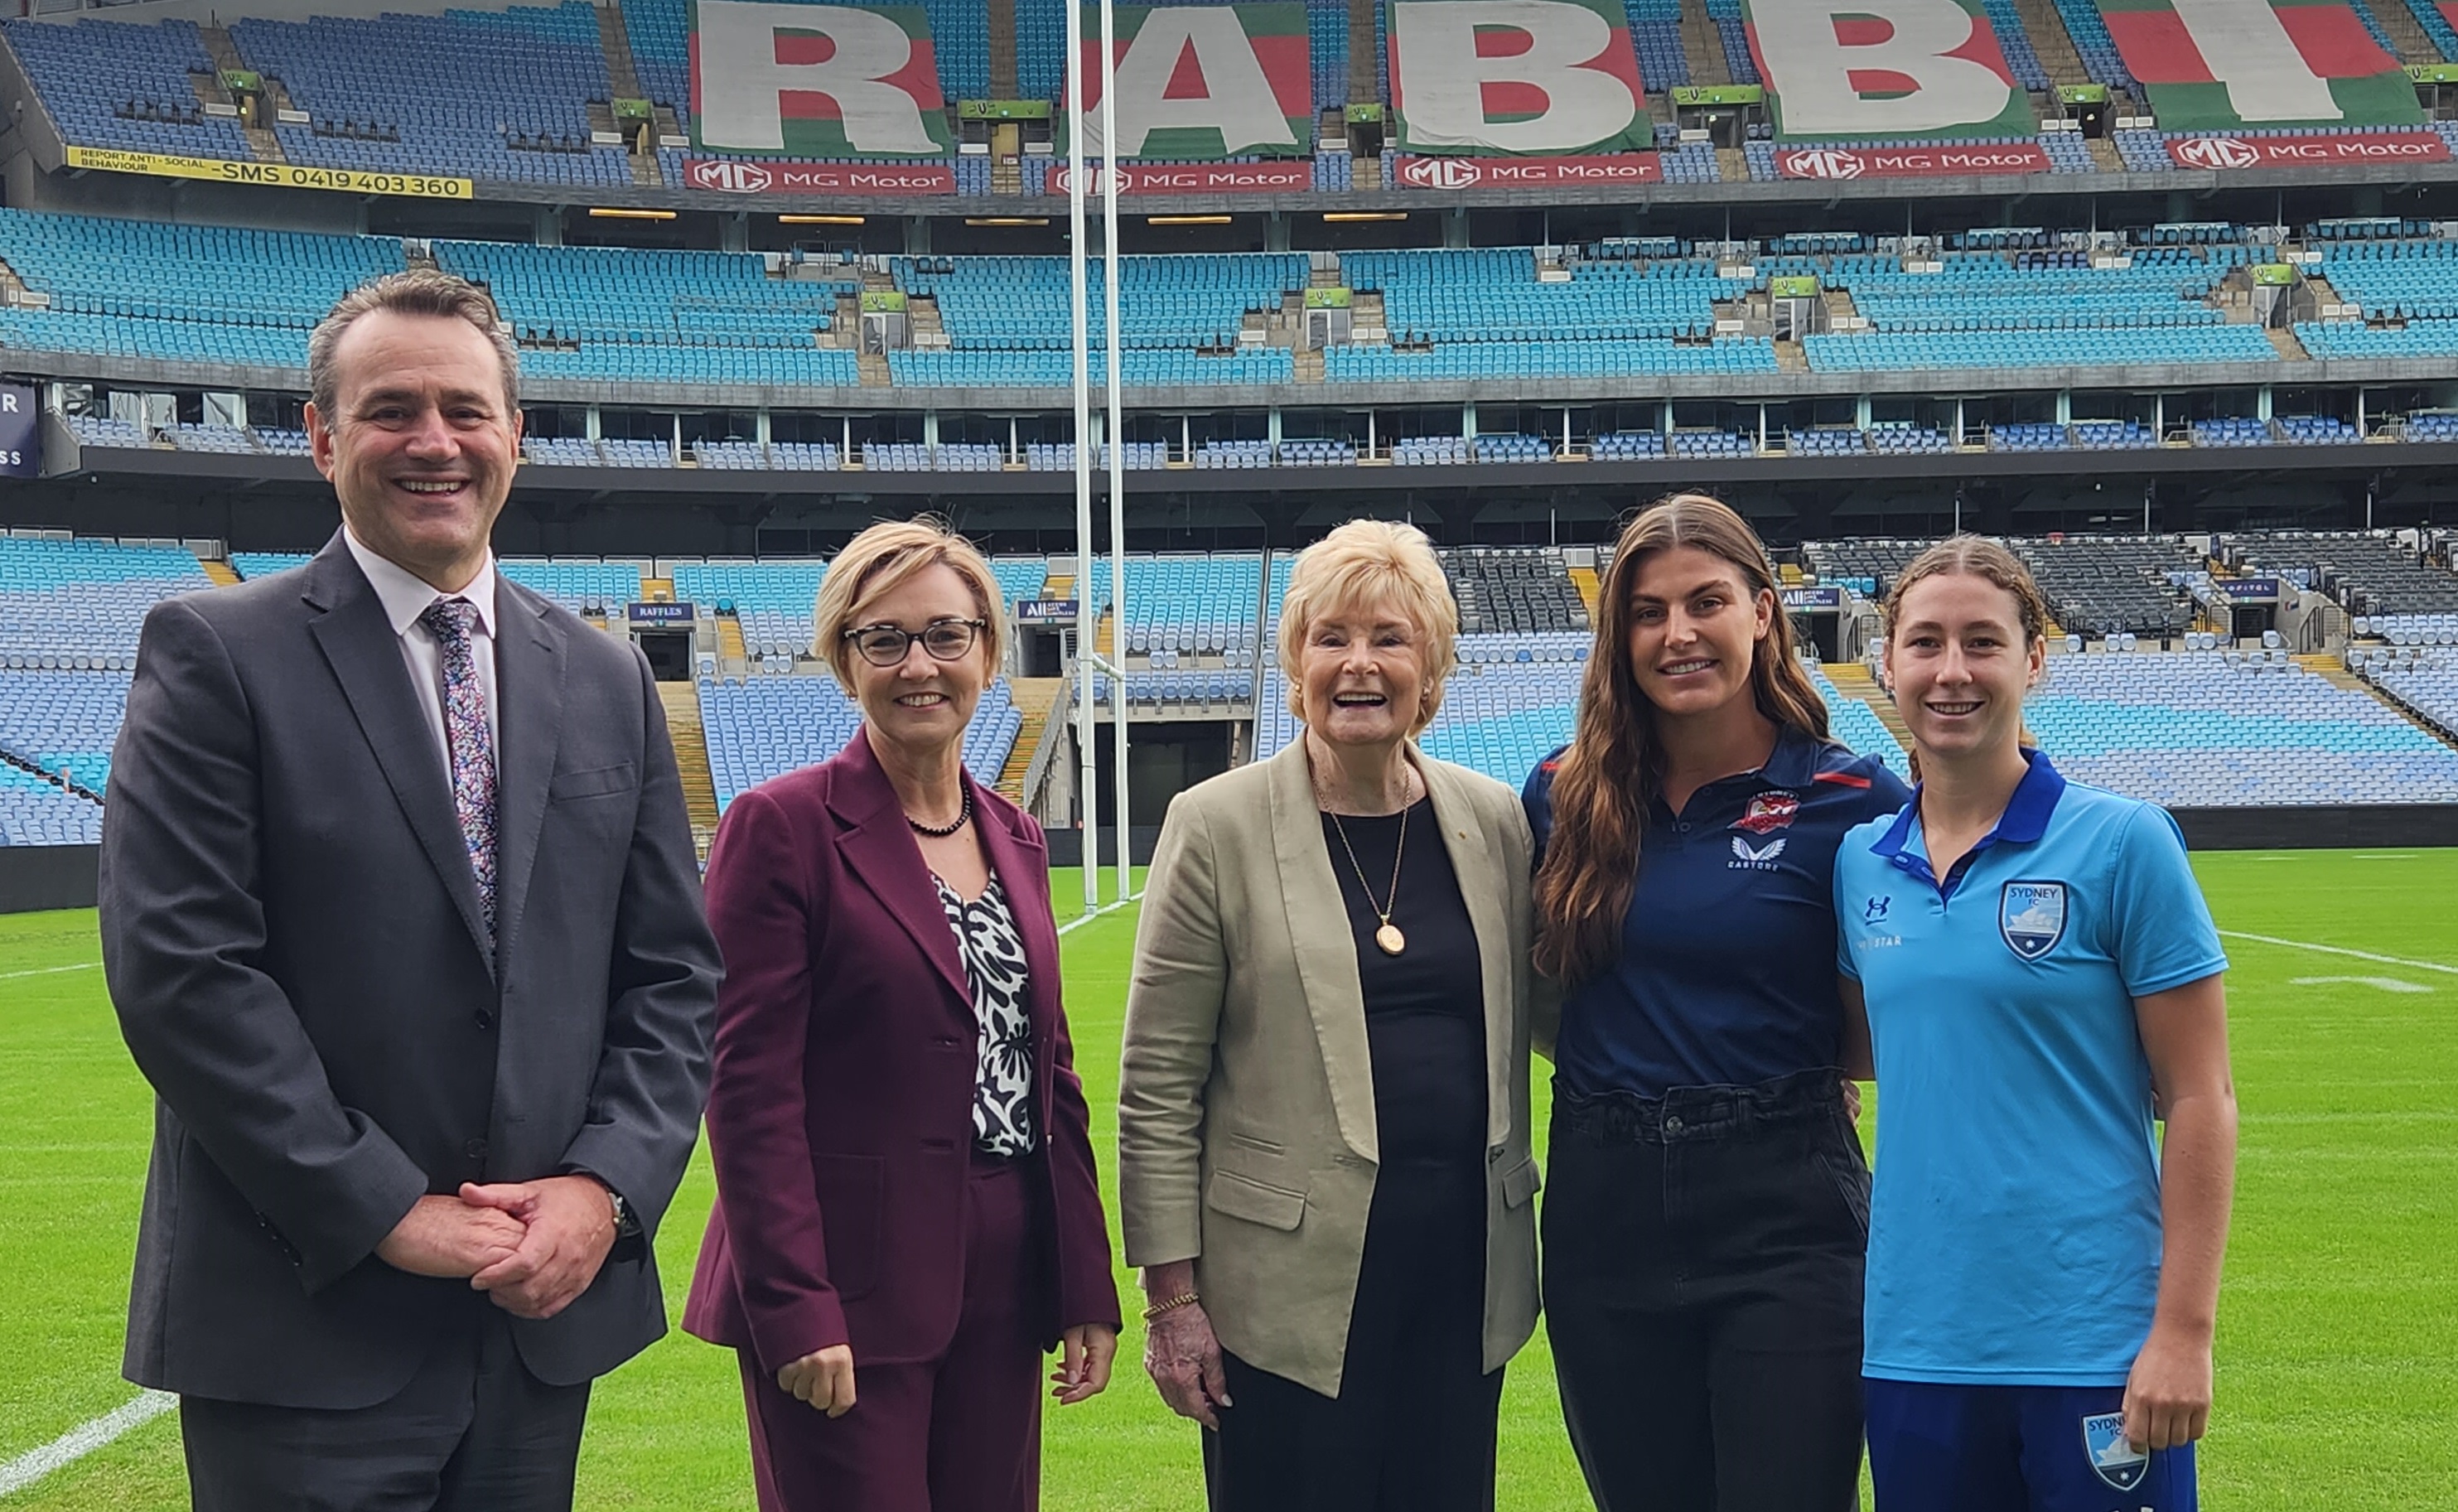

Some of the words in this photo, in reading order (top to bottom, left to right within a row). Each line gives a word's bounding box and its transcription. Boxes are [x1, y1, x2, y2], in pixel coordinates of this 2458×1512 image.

[80, 148, 126, 161] REPORT
[2184, 140, 2253, 167] MG
[2267, 143, 2328, 158] MG
[2335, 142, 2437, 156] Motor
[81, 157, 148, 171] BEHAVIOUR
[1793, 152, 1858, 179] MG
[1875, 155, 1932, 169] MG
[1940, 152, 2038, 167] Motor
[700, 162, 765, 191] MG
[1143, 174, 1197, 186] MG
[1209, 171, 1303, 185] Motor
[1410, 160, 1475, 187] MG
[1492, 166, 1547, 179] MG
[1557, 164, 1653, 177] Motor
[292, 168, 351, 188] 0419
[356, 174, 405, 193] 403
[410, 177, 460, 196] 360
[784, 172, 839, 186] MG
[850, 173, 944, 188] Motor
[2010, 887, 2058, 899] SYDNEY
[1874, 935, 1902, 948] STAR
[2089, 1415, 2126, 1432] SYDN
